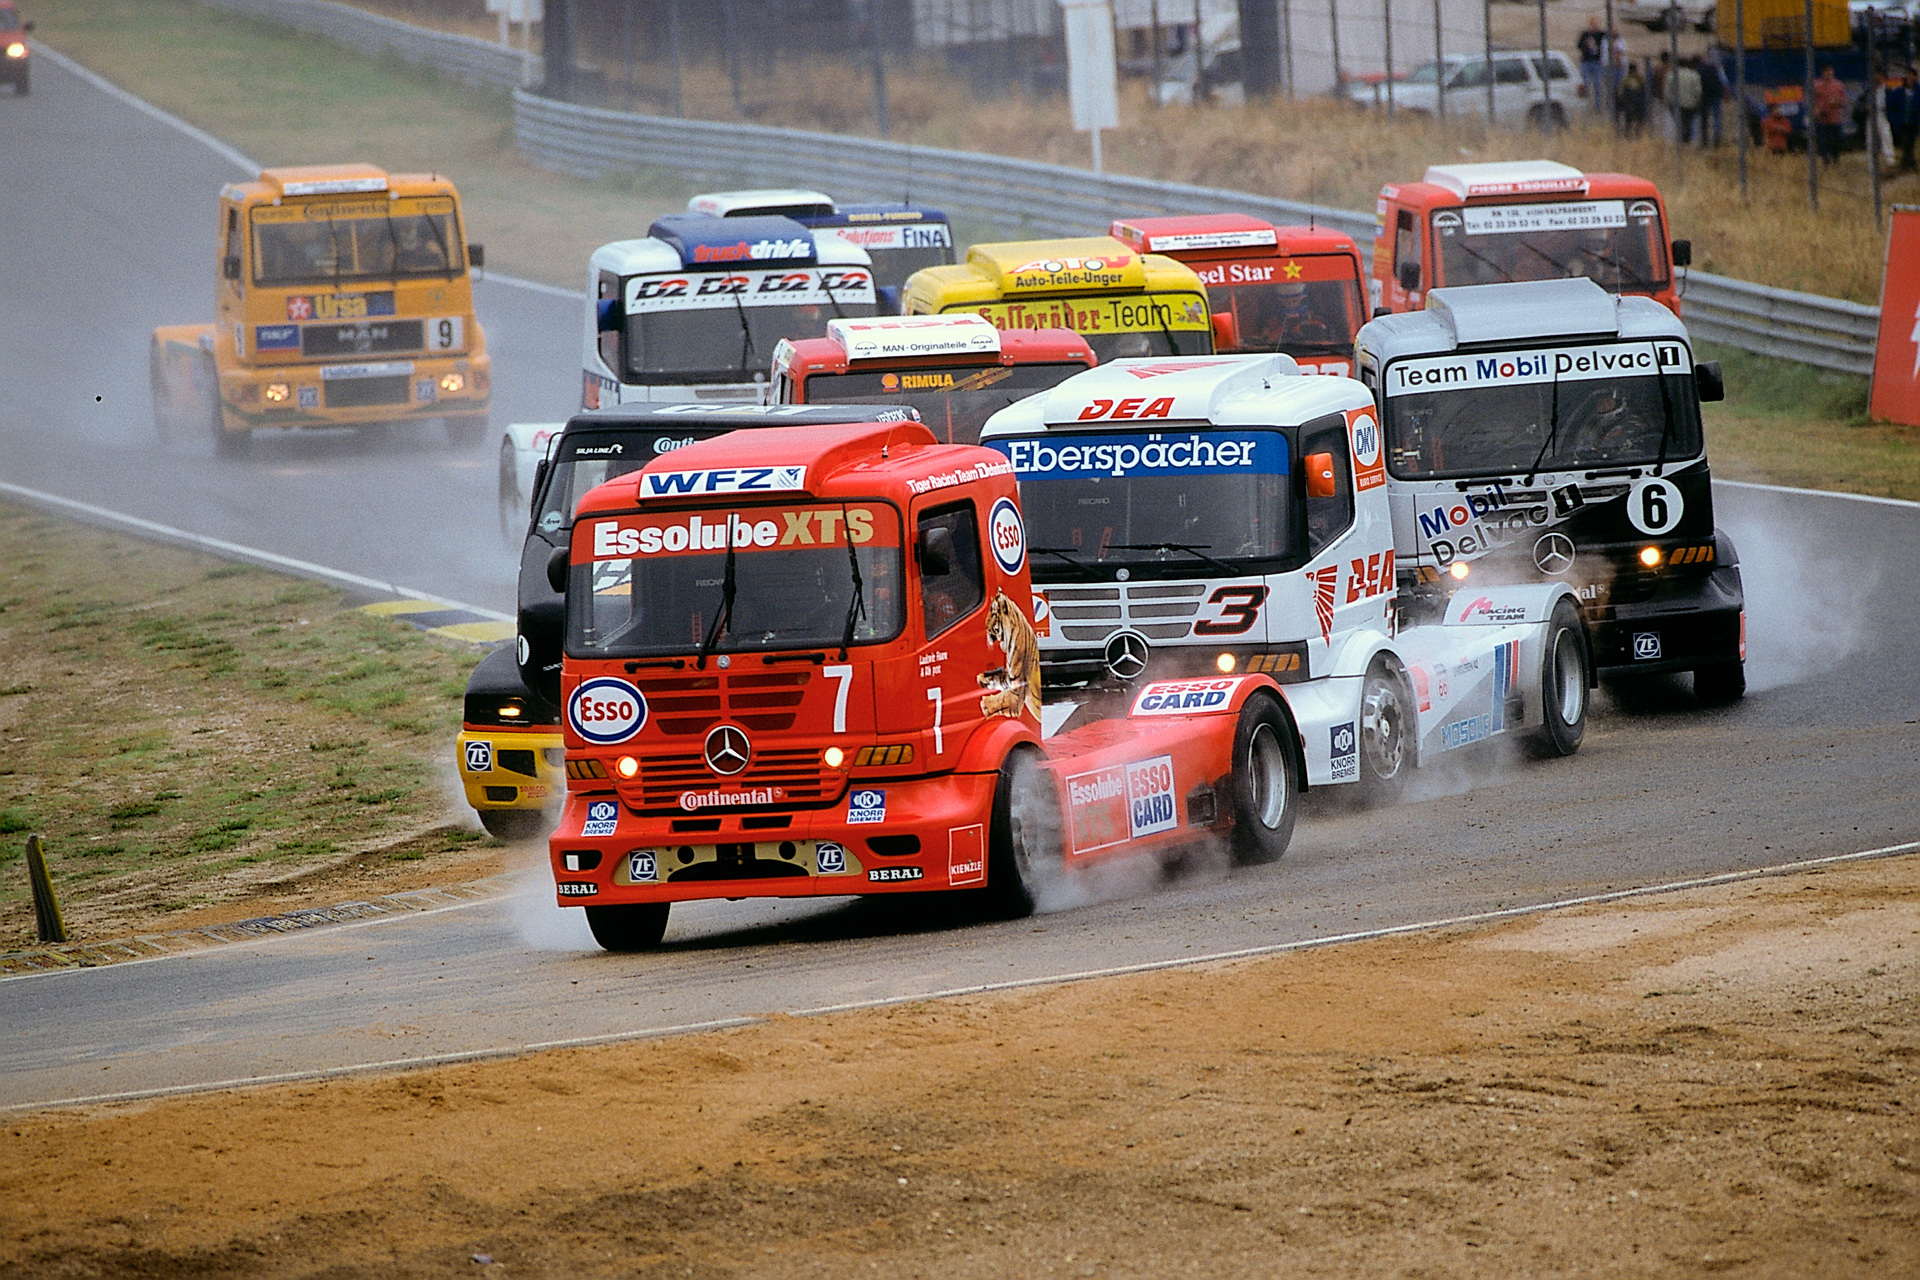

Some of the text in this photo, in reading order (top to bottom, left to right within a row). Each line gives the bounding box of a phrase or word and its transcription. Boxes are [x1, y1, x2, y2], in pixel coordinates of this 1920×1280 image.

[902, 228, 945, 247] FINA
[1016, 272, 1124, 288] Auto-Teile-Unger
[1229, 264, 1274, 283] Star
[635, 279, 689, 300] D2
[696, 276, 750, 296] D2
[757, 273, 811, 293] D2
[438, 319, 453, 349] 9
[1395, 365, 1468, 388] Team
[1476, 355, 1548, 380] Mobil
[1556, 349, 1652, 374] Delvac
[902, 374, 954, 389] RIMULA
[1077, 397, 1176, 421] DEA
[1356, 425, 1376, 456] DKV
[1008, 434, 1257, 477] Eberspächer
[648, 467, 776, 496] WFZ
[906, 479, 930, 493] Tiger
[929, 473, 958, 489] Racing
[955, 469, 979, 484] Team
[1418, 483, 1508, 539] Mobil
[1641, 483, 1669, 530] 6
[594, 508, 874, 556] Essolube XTS
[1430, 504, 1549, 567] Delvac
[1346, 549, 1395, 605] DEA
[1193, 586, 1271, 636] 3
[1637, 637, 1660, 656] ZF
[823, 664, 853, 733] 7
[1148, 680, 1234, 696] ESSO
[1140, 691, 1227, 711] CARD
[927, 686, 943, 754] 7
[1441, 714, 1490, 751] MOSOLF
[469, 748, 488, 765] ZF
[1330, 758, 1356, 771] KNORR
[1129, 763, 1171, 799] ESSO
[1331, 767, 1356, 780] BREMSE
[679, 788, 774, 811] Continental
[1069, 773, 1123, 806] Essolube
[848, 815, 884, 824] BREMSE
[849, 808, 885, 819] KNORR
[1073, 801, 1113, 844] XTS
[1133, 794, 1173, 828] CARD
[583, 827, 615, 836] BREMSE
[585, 820, 617, 830] KNORR
[631, 854, 656, 878] ZF
[818, 846, 843, 871] ZF
[950, 860, 982, 876] KIENZLE
[868, 868, 923, 882] BERAL
[557, 882, 598, 896] BERAL
